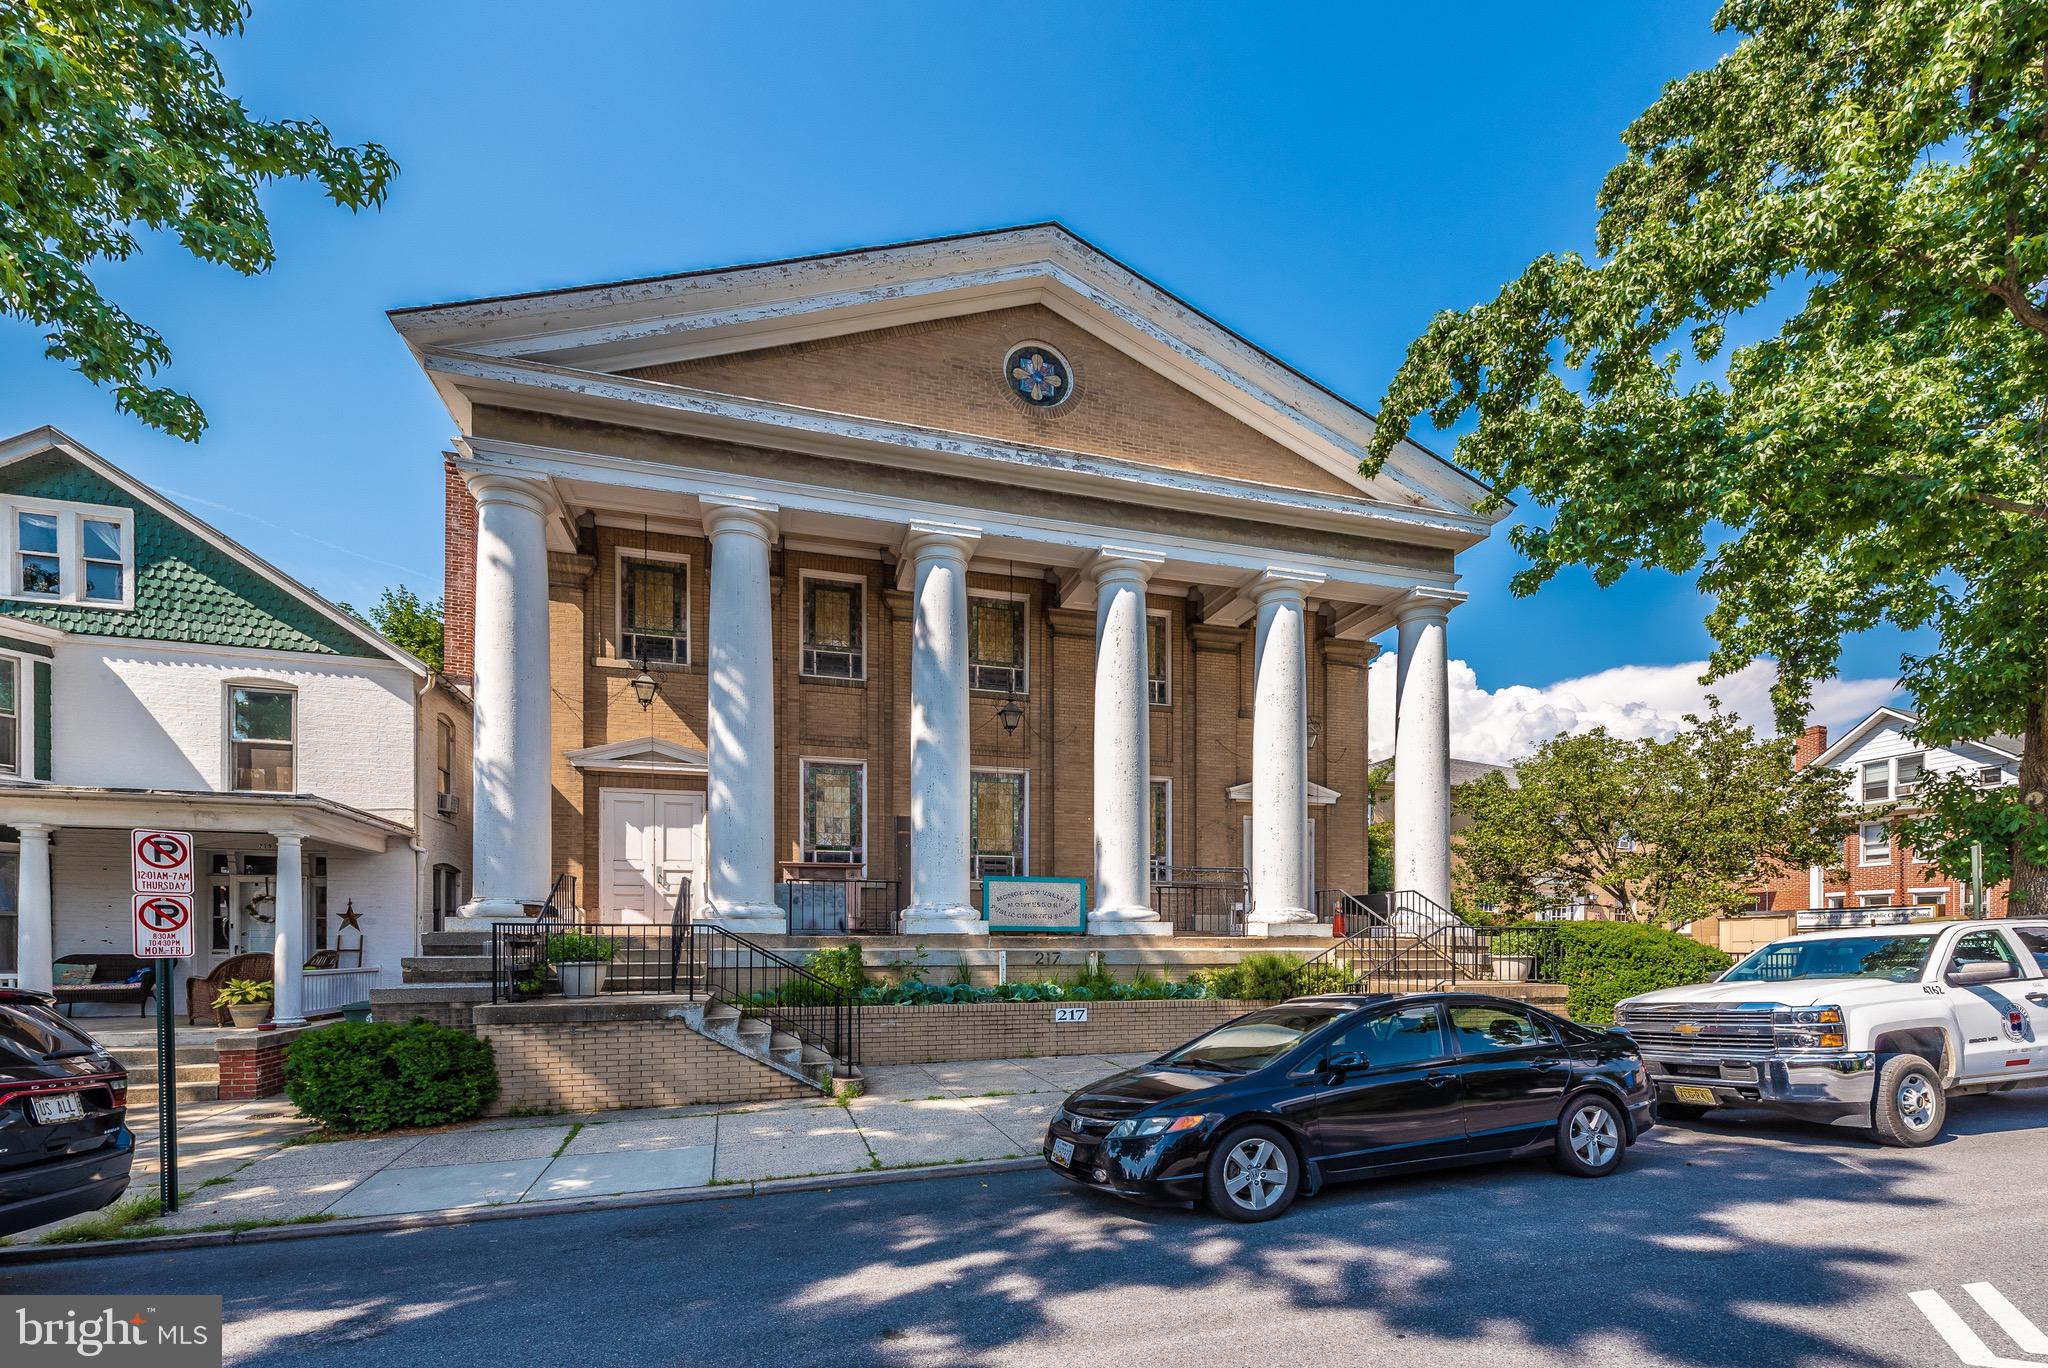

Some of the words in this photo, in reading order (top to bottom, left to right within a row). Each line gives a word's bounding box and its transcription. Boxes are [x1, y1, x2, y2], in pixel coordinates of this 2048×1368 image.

[142, 881, 186, 890] THURSDAY
[996, 889, 1041, 902] MONOCACY
[1042, 890, 1070, 903] VALLEY
[990, 904, 1016, 919] PUBLIC
[1017, 912, 1053, 920] CHARTER
[1054, 902, 1079, 919] SCHOOL
[144, 947, 185, 955] MON-FRI
[1035, 952, 1061, 965] 217
[1923, 985, 1945, 995] 4762
[1057, 1009, 1086, 1021] 217
[31, 1080, 96, 1090] DODGE
[40, 1102, 52, 1116] US
[58, 1099, 76, 1114] ALL
